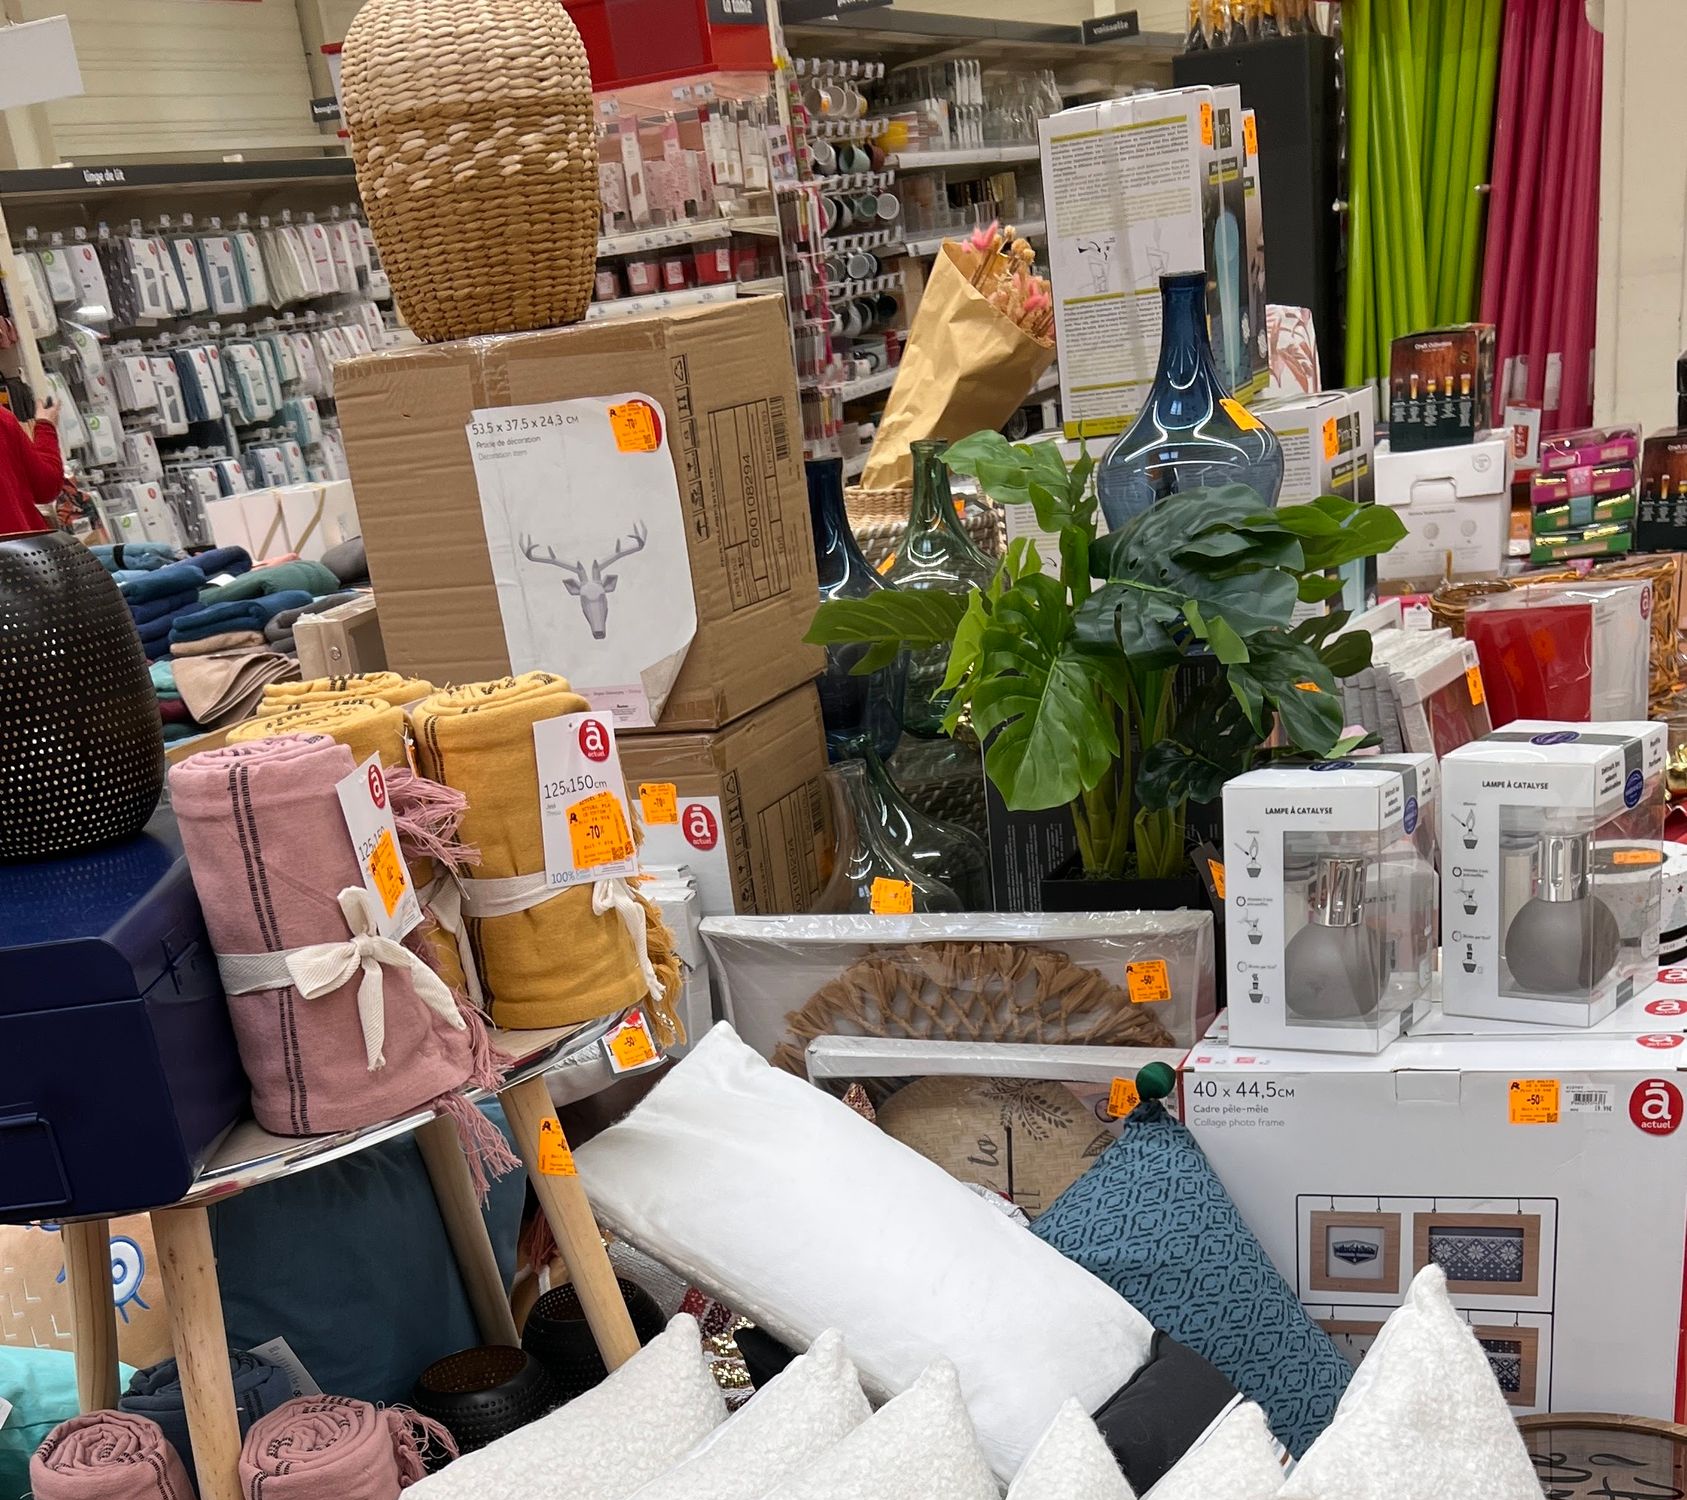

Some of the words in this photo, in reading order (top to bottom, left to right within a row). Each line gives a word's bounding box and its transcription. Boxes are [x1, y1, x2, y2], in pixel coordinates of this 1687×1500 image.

[1093, 20, 1129, 35] vaisselle
[83, 169, 104, 185] linge
[497, 424, 503, 433] x
[476, 440, 496, 449] Article
[498, 439, 506, 447] de
[1482, 781, 1505, 789] LAMPE
[1506, 779, 1512, 789] À
[1513, 781, 1549, 790] CATALYSE
[1265, 807, 1289, 815] LAMPE
[1290, 805, 1296, 815] À
[1297, 807, 1333, 815] CATALYSE
[1194, 1081, 1217, 1098] 40
[1223, 1088, 1230, 1097] x
[1526, 1094, 1544, 1104] -50%
[1193, 1105, 1220, 1113] Cadre
[1222, 1104, 1269, 1117] pêle-mêle
[1194, 1119, 1227, 1128] Collage
[1229, 1119, 1256, 1128] photo
[1641, 1121, 1671, 1129] actuel
